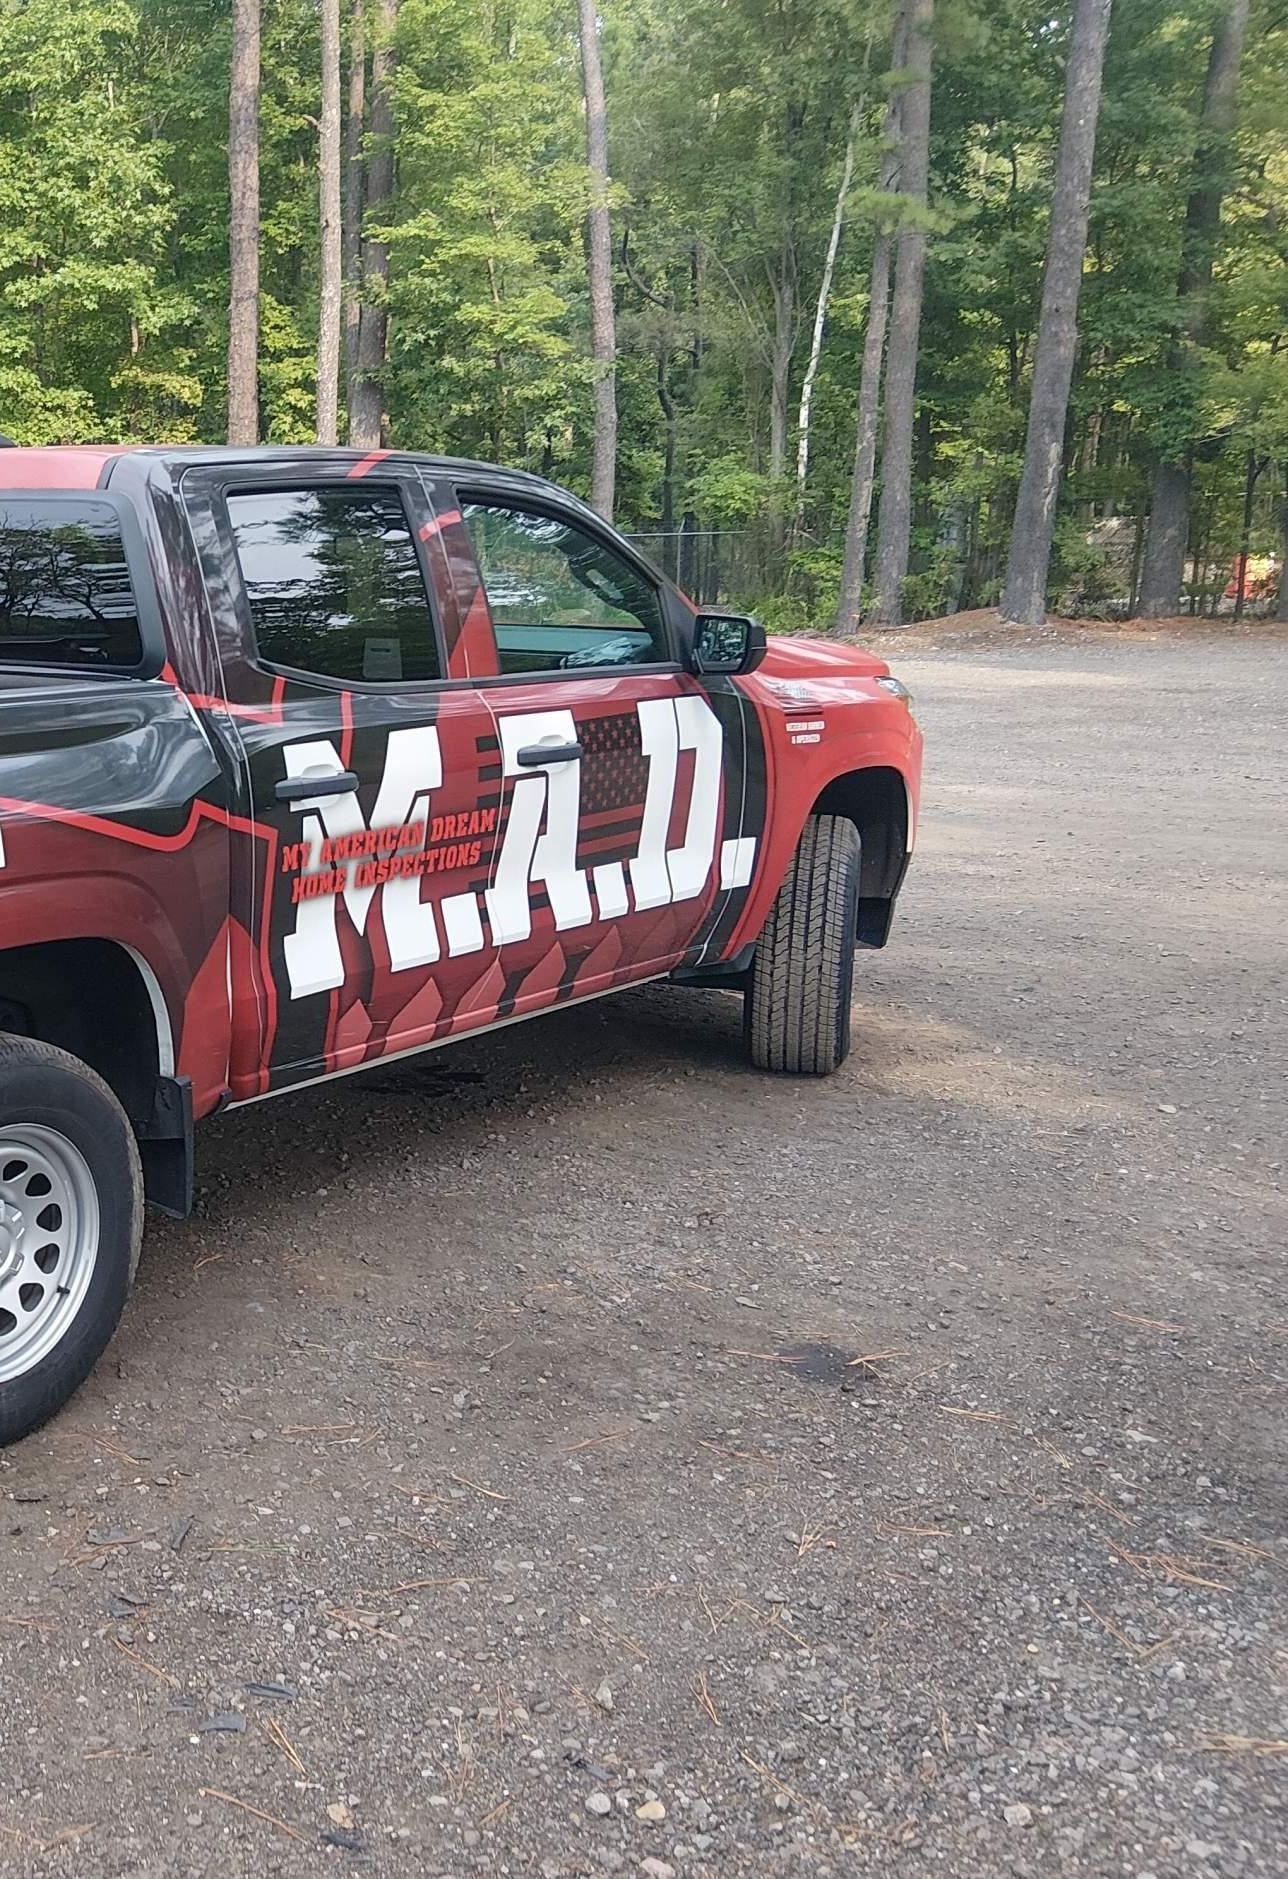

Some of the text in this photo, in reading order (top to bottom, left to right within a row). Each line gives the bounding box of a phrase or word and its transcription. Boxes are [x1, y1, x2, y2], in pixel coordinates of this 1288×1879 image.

[281, 808, 496, 873] MY AMERICAN DREAM
[291, 840, 482, 903] HOME INSPECTIONS
